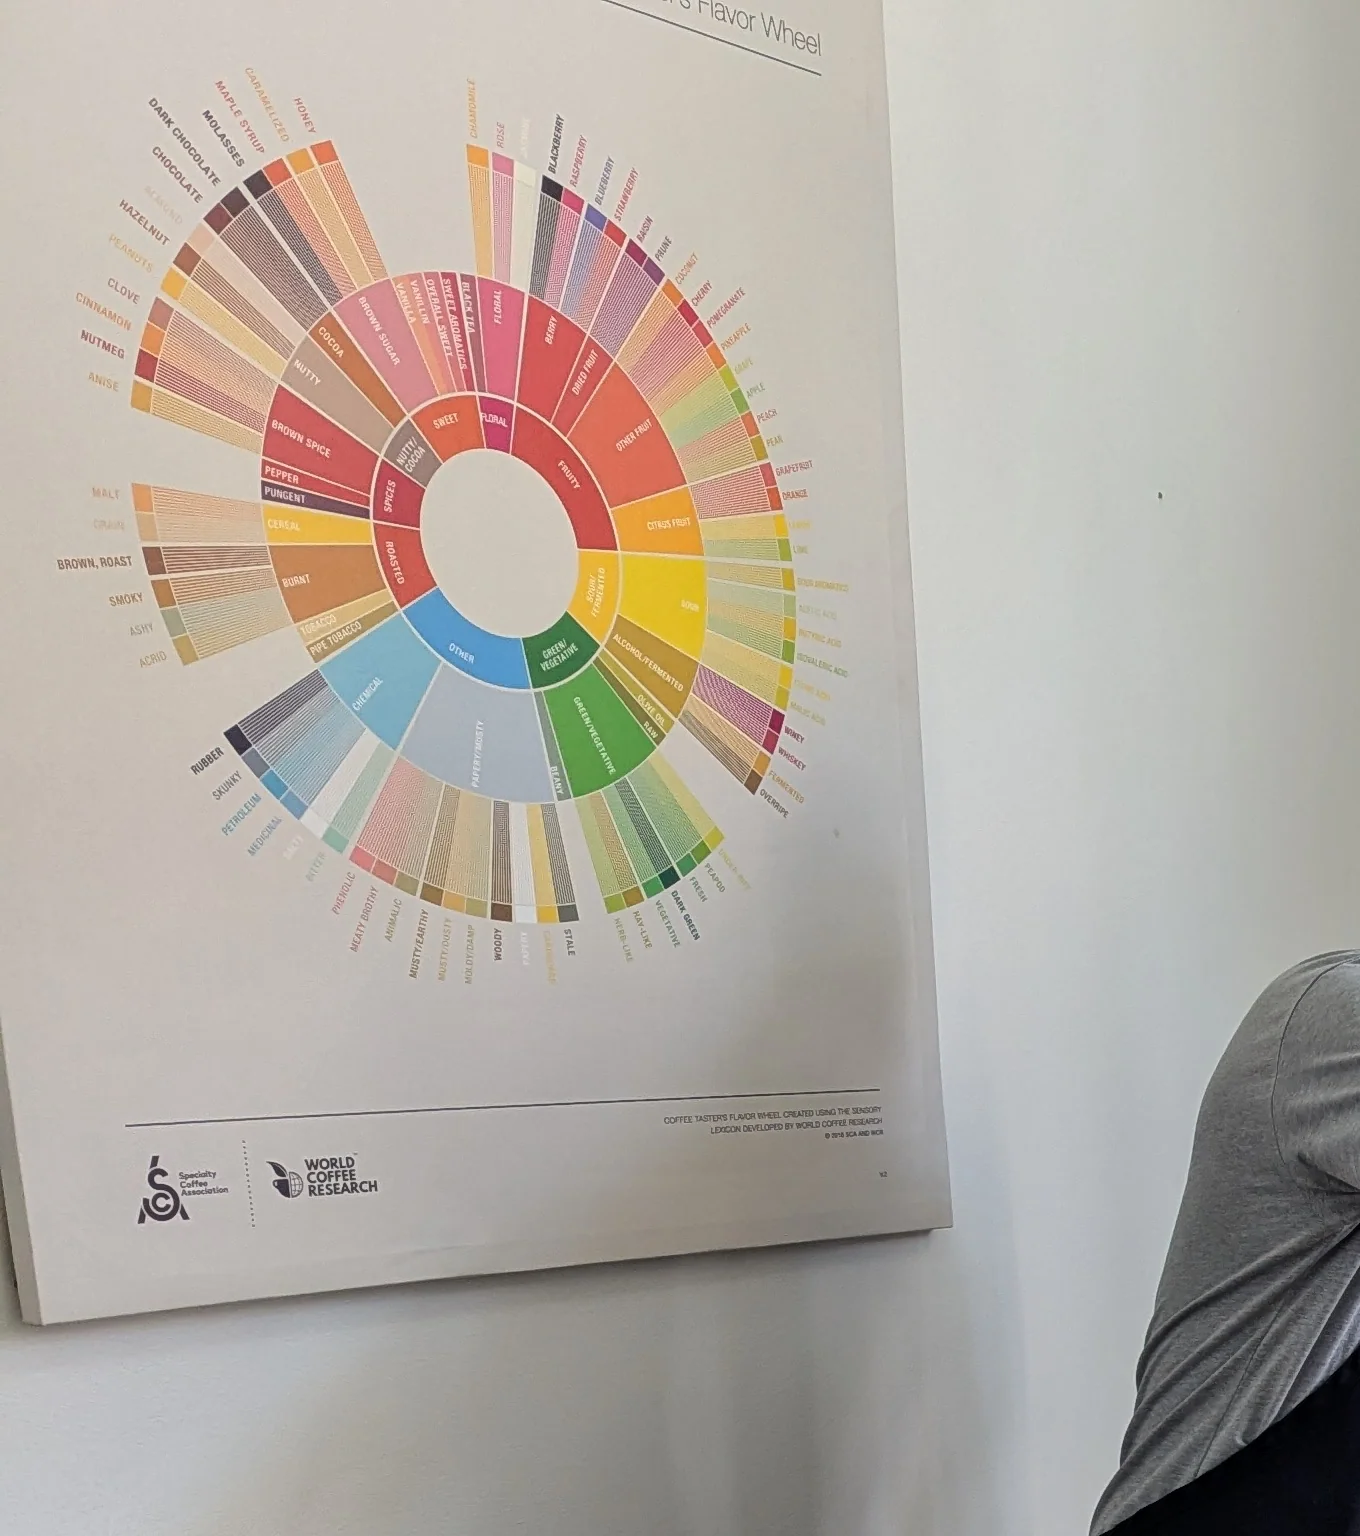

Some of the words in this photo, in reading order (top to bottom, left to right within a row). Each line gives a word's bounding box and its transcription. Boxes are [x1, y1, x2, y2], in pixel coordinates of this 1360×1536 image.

[698, 0, 756, 31] Flavor
[761, 12, 822, 56] Wheel
[215, 80, 243, 118] MAPLE
[239, 119, 265, 153] SYRUP
[245, 67, 290, 142] CARAMELIZED
[294, 96, 317, 134] HONEY
[467, 78, 478, 139] CHAMOMILE
[148, 97, 175, 129] DARK
[172, 127, 222, 187] CHOCOLATE
[202, 110, 245, 167] MOLASSES
[496, 122, 505, 149] ROSE
[547, 114, 565, 174] BLACKBERRY
[152, 146, 204, 204] CHOCOLATE
[570, 135, 588, 188] RASPBERRY
[594, 155, 616, 206] BLUEBERRY
[613, 167, 639, 222] STRAWBERRY
[119, 199, 170, 246] HAZELNUT
[635, 215, 653, 243] RAISIN
[108, 234, 154, 273] PEANUTS
[654, 235, 673, 262] PRUNE
[674, 252, 699, 285] COCONUT
[107, 277, 141, 305] CLOVE
[395, 282, 417, 323] VANILLA
[461, 281, 473, 313] BLACK
[691, 280, 713, 307] CHERRY
[75, 292, 132, 331] CINNAMON
[493, 289, 502, 325] FLORAL
[358, 296, 380, 334] BROWN
[378, 333, 400, 366] SUGAR
[466, 315, 476, 333] TEA
[544, 315, 558, 345] BERRY
[80, 329, 125, 360] NUTMEG
[318, 326, 345, 359] COCOA
[88, 372, 119, 392] ANISE
[293, 358, 322, 386] NUTTY
[571, 371, 589, 396] DRIED
[585, 349, 598, 372] FRUIT
[432, 412, 459, 430] SWEET
[756, 408, 778, 424] PEACH
[271, 419, 304, 444] BROWN
[305, 437, 332, 459] SPICE
[615, 430, 636, 452] OTHER
[635, 418, 653, 436] FRUIT
[766, 434, 784, 447] PEAR
[404, 445, 426, 473] COCOA
[557, 459, 581, 490] FRUITY
[264, 465, 300, 485] PEPPER
[264, 486, 306, 503] PUNGENT
[383, 479, 396, 513] SPICES
[56, 556, 99, 570] BROWN,
[100, 555, 133, 569] ROAST
[385, 541, 405, 585] ROASTED
[282, 574, 310, 587] BURNT
[109, 592, 143, 607] SMOKY
[129, 623, 154, 637] ASHY
[309, 639, 328, 656] PIPE
[327, 621, 362, 646] TOBACCO
[139, 651, 168, 668] ACRID
[449, 642, 475, 664] OTHER
[540, 642, 578, 672] VEGETATIVE
[612, 633, 684, 692] ALCOHOL/FERMENTED
[352, 677, 384, 711] CHEMICAL
[638, 694, 656, 715] OLIVE
[573, 696, 617, 775] GREEN/VEGETATIVE
[643, 721, 659, 739] RAW
[784, 725, 805, 744] WINEY
[190, 746, 225, 775] RUBBER
[778, 746, 807, 771] WHISKEY
[212, 770, 243, 801] SKUNKY
[550, 766, 564, 795] BEANY
[221, 792, 262, 836] PETROLEUM
[759, 788, 789, 819] OVERRIPE
[247, 816, 283, 857] MEDICINAL
[332, 871, 357, 915] PHENOLIC
[689, 876, 708, 903] FRESH
[704, 863, 726, 893] PEAPOD
[350, 922, 366, 952] MEATY
[361, 885, 379, 921] BROTHY
[384, 898, 403, 942] ANIMALIC
[632, 910, 652, 949] HAY-LIKE
[655, 900, 681, 948] VEGETATIVE
[671, 890, 688, 914] DARK
[683, 913, 700, 941] GREEN
[408, 908, 429, 979] MUSTY/EARTHY
[493, 927, 503, 961] WOODY
[563, 928, 576, 956] STALE
[663, 1115, 693, 1125] COFFEE
[729, 1111, 756, 1121] FLAVOR
[757, 1110, 782, 1120] WHEEL
[783, 1109, 814, 1118] CREATED
[815, 1108, 836, 1117] USING
[838, 1107, 851, 1115] THE
[710, 1125, 742, 1135] LEXICON
[742, 1123, 784, 1133] DEVELOPED
[784, 1122, 795, 1131] BY
[795, 1120, 821, 1130] WORLD
[821, 1119, 847, 1128] COFFEE
[848, 1118, 883, 1127] RESEARCH
[178, 1170, 217, 1181] Specialty
[304, 1156, 355, 1171] WORLD
[306, 1169, 356, 1183] COFFEE
[179, 1180, 208, 1189] Coffee
[180, 1186, 229, 1197] Association
[308, 1180, 378, 1197] RESEARCH
